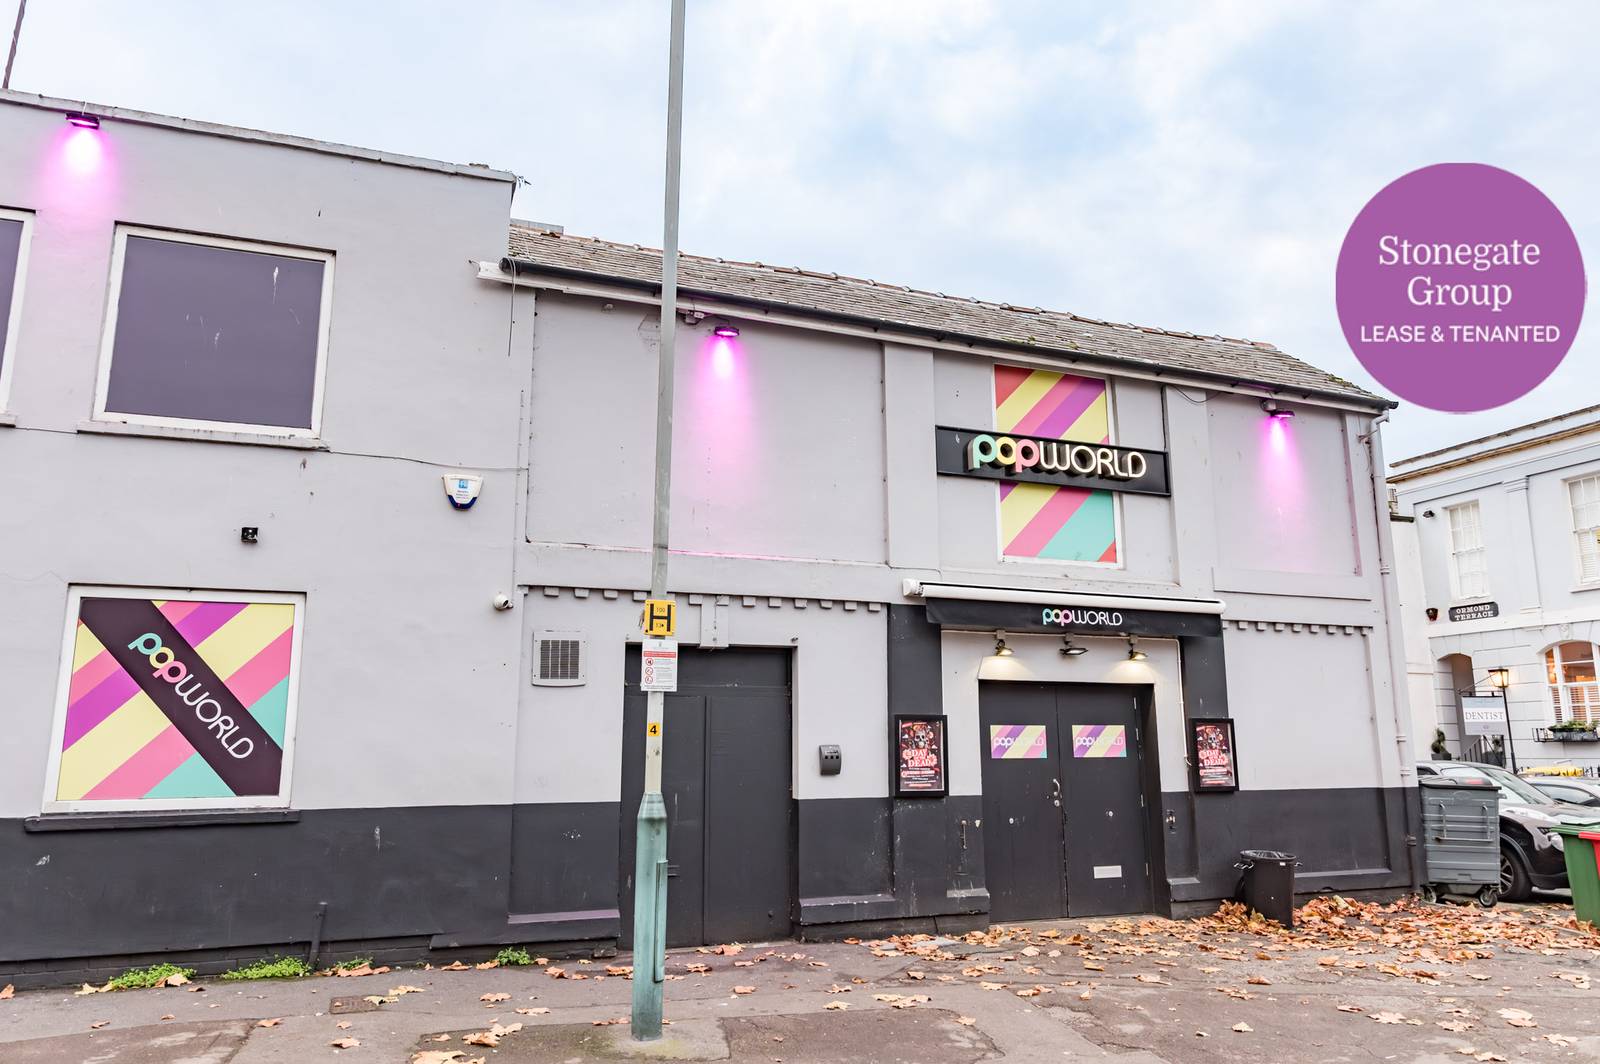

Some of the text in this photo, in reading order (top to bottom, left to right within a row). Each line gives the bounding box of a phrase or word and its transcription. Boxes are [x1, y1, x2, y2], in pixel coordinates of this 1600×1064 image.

[1456, 604, 1490, 614] ORMOND
[1455, 611, 1494, 621] TERRACE
[1465, 711, 1504, 720] DENTIST
[649, 724, 658, 735] 4
[908, 759, 931, 767] DEAD
